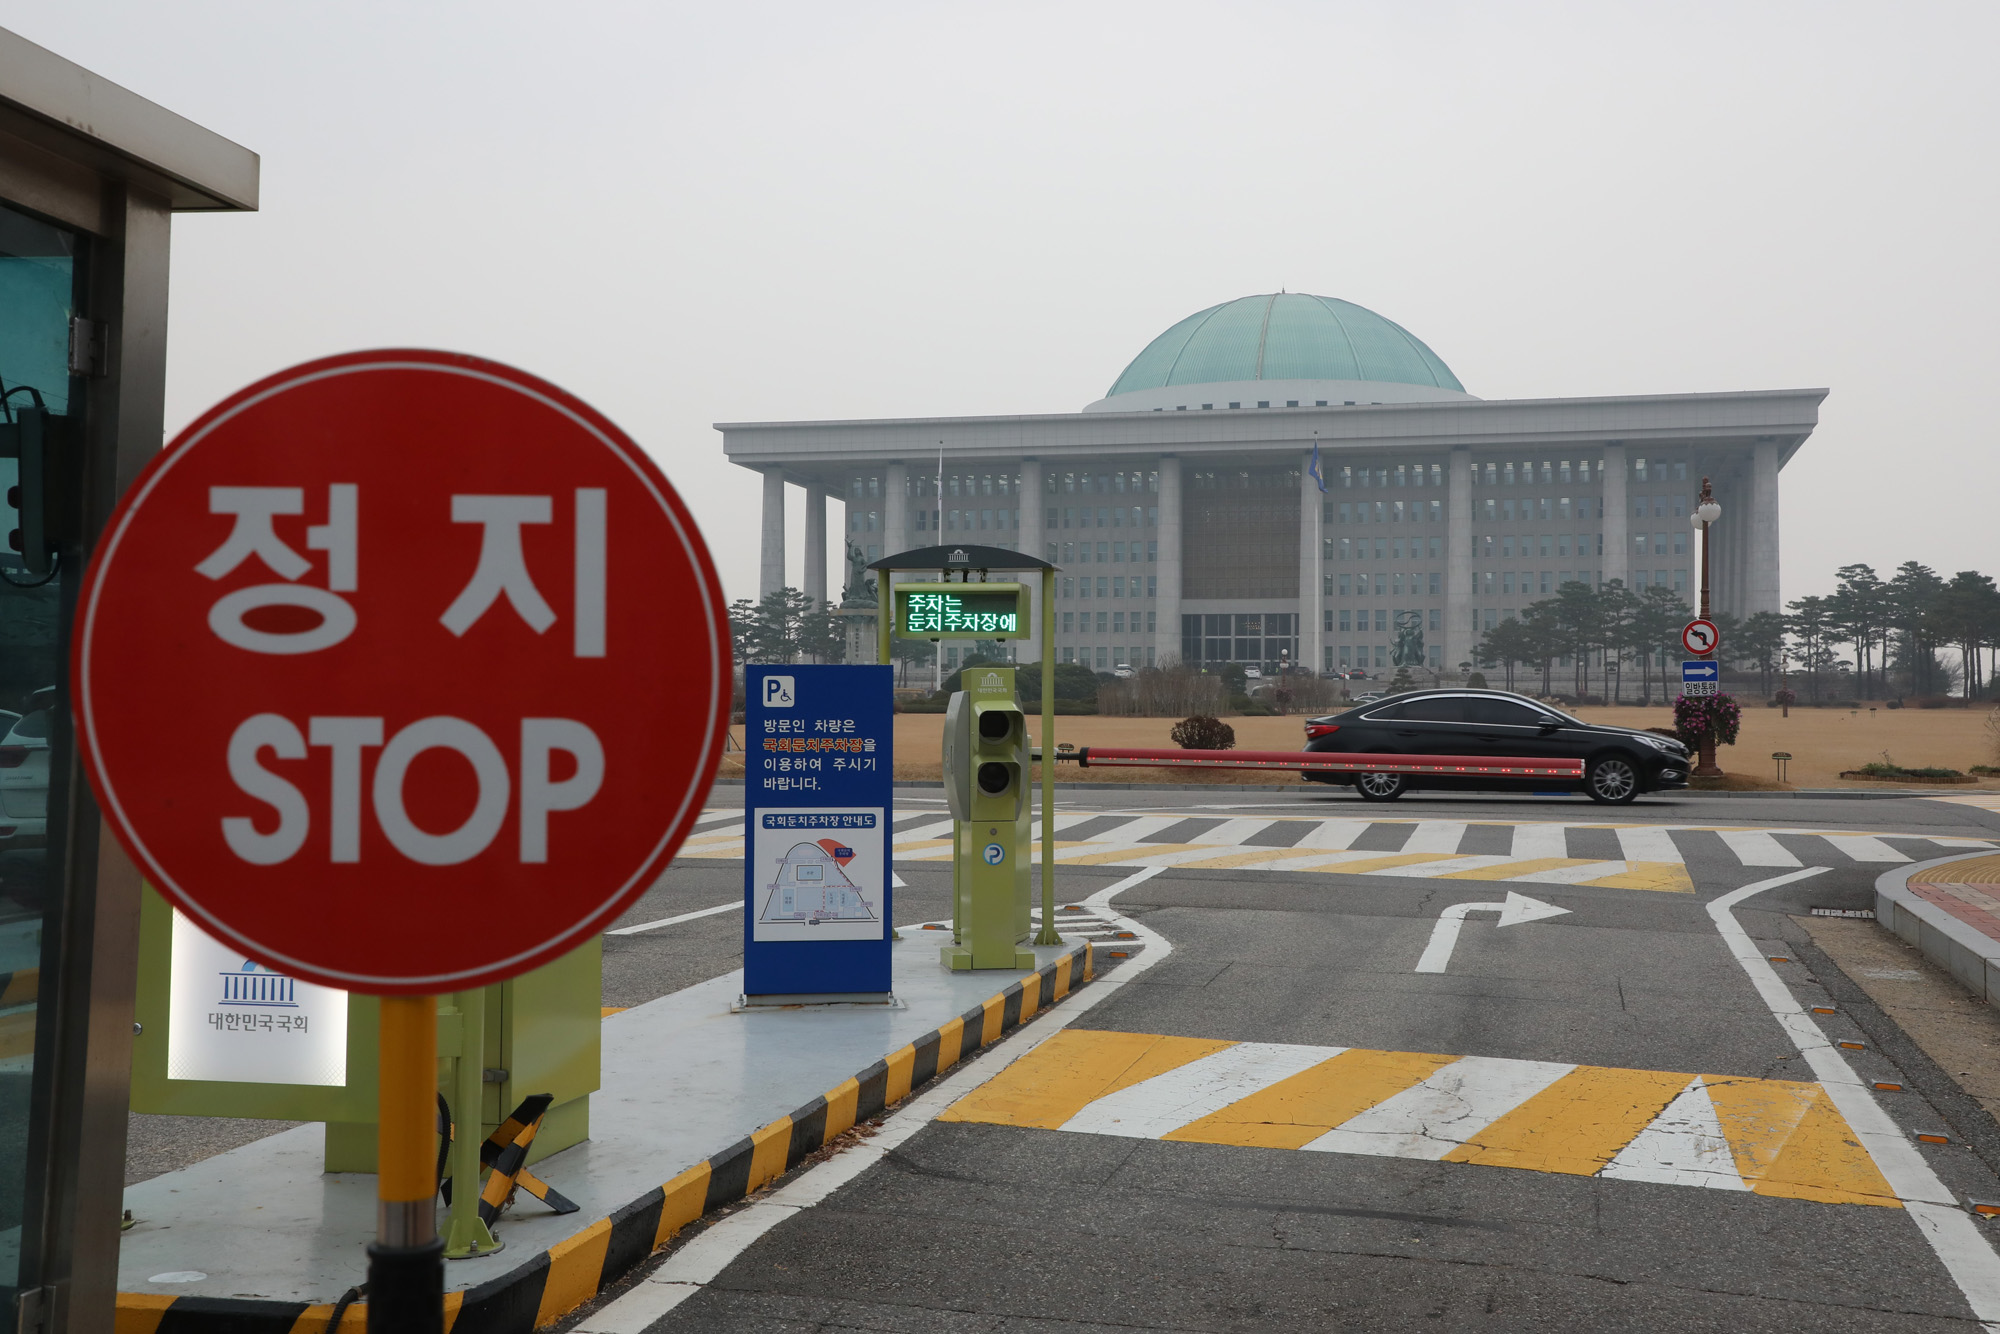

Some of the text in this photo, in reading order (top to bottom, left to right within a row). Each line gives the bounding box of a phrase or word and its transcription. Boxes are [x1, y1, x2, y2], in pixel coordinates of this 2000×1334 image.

[908, 594, 962, 613] 주차는
[908, 613, 1017, 632] 둔치주차장에
[767, 679, 781, 702] P
[1685, 682, 1717, 695] 일방통행
[763, 719, 856, 733] 방문인 차량은
[762, 737, 877, 753] 국회둔치주차장을
[763, 757, 876, 772] 이용하여 주시기
[220, 712, 605, 866] STOP
[763, 776, 821, 791] 바랍니다.
[765, 815, 874, 827] 국회둔치주차장 안내도
